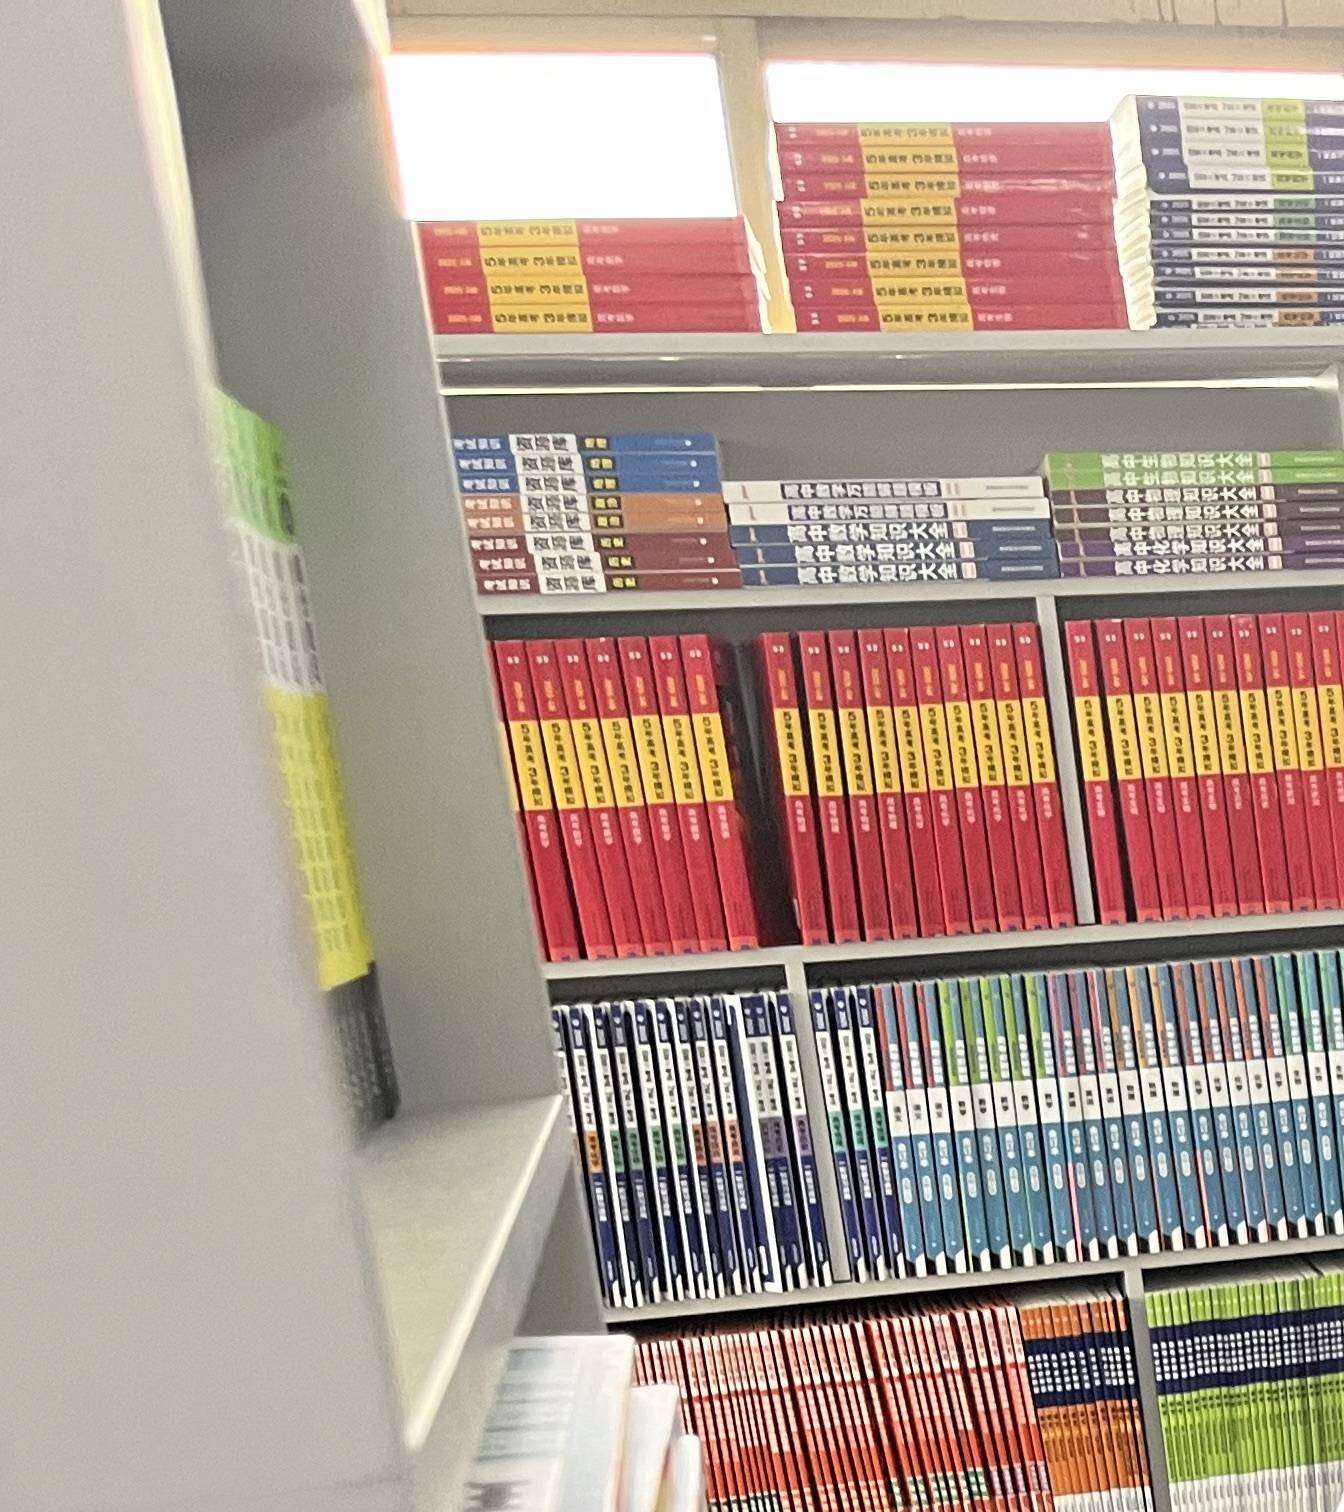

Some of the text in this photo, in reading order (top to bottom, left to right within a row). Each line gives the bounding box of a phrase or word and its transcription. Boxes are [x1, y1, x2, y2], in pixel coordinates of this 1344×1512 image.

[1102, 452, 1252, 468] 高中生物知识大全
[1103, 468, 1254, 486] 高中生物知识大全
[788, 522, 948, 542] 高中数学知识大全
[795, 542, 955, 563] 高中数学知识大全
[1114, 538, 1264, 556] 高中化学知识大全
[798, 563, 958, 584] 高中数学知识大全
[1114, 558, 1264, 575] 高中化学知识大全
